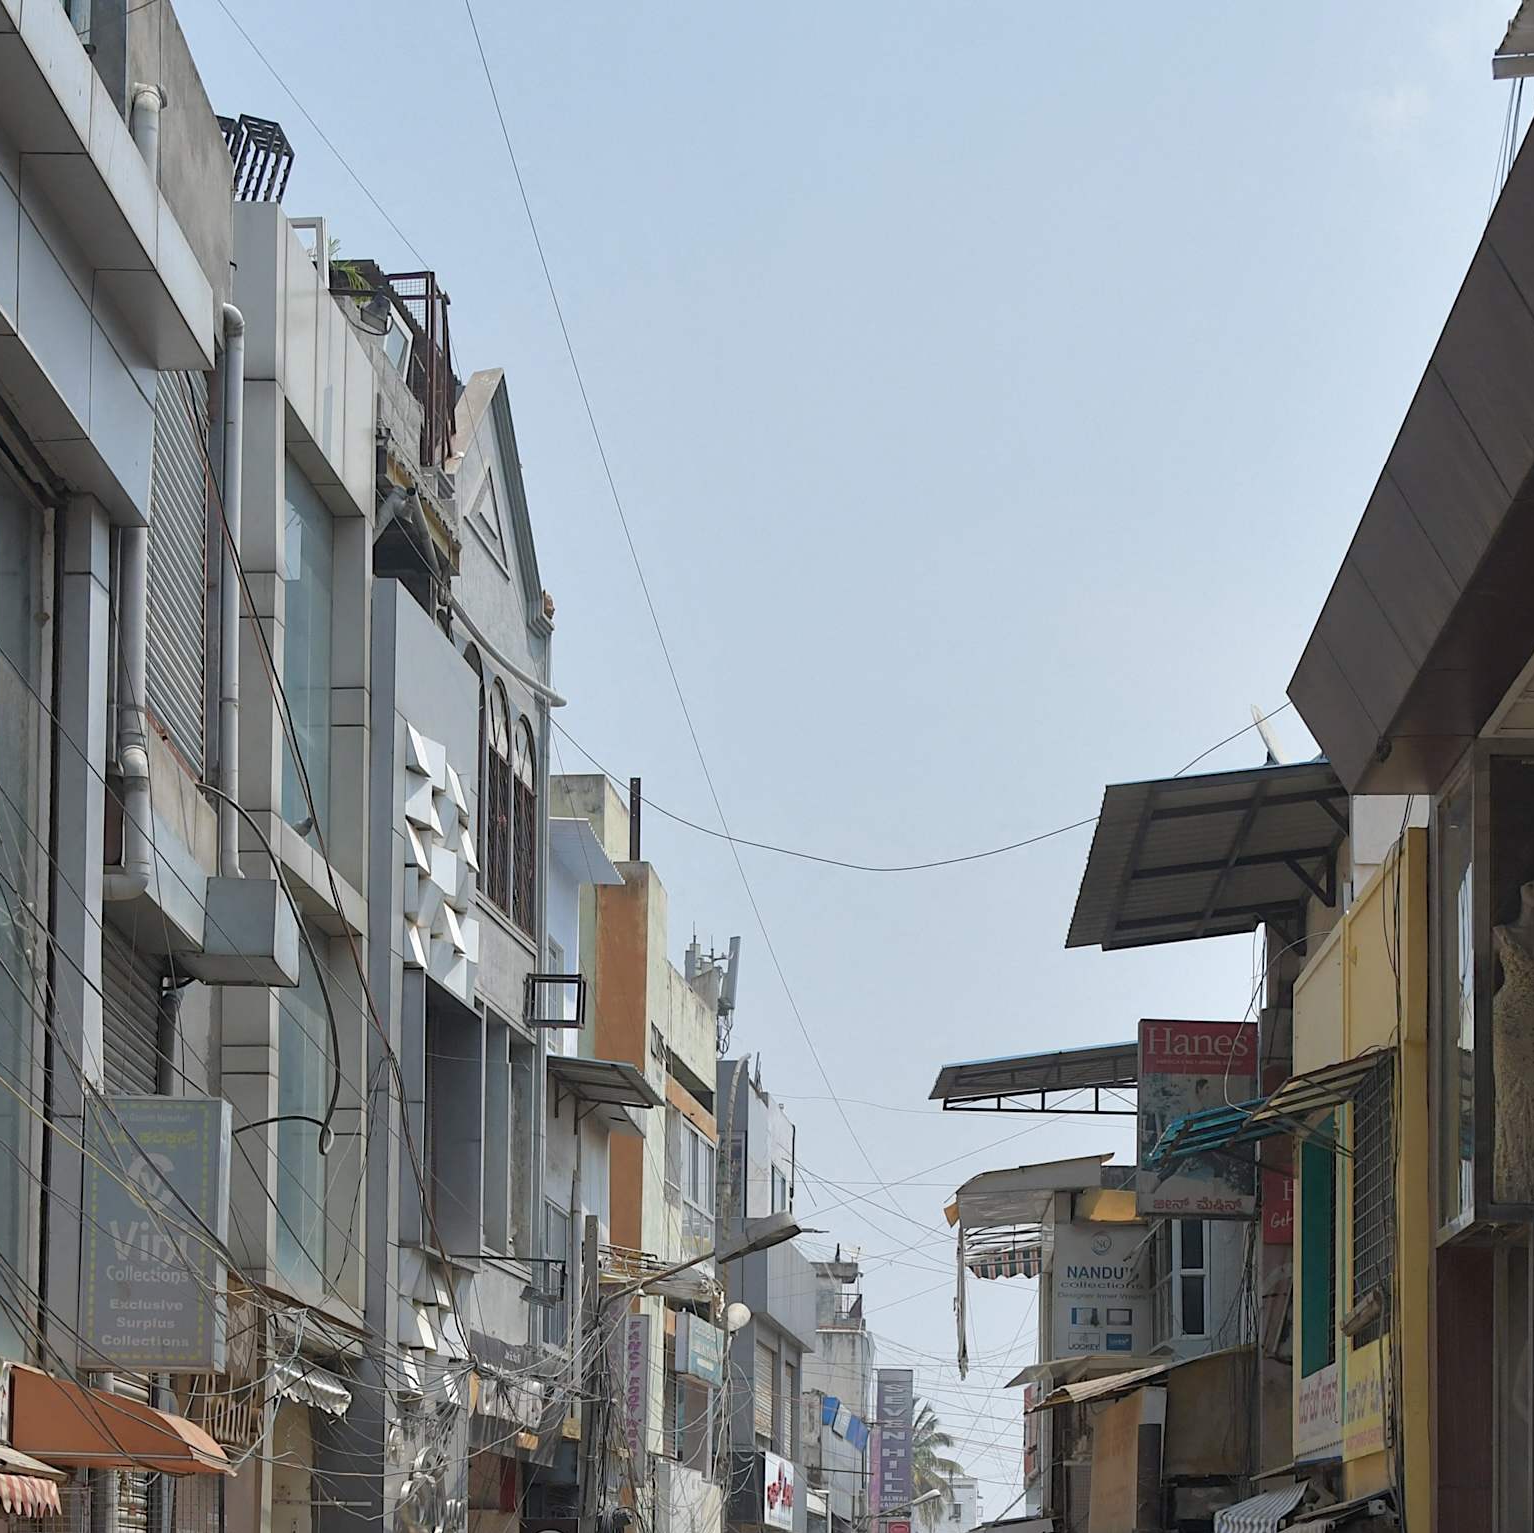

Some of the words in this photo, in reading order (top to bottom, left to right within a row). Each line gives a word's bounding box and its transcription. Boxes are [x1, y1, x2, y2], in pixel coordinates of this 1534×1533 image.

[1146, 1025, 1249, 1057] Hanes
[106, 1264, 190, 1284] Collections
[110, 1298, 184, 1312] Exclusive
[117, 1316, 176, 1331] Surplus
[101, 1334, 190, 1348] Collections
[882, 1383, 907, 1441] SEVEN
